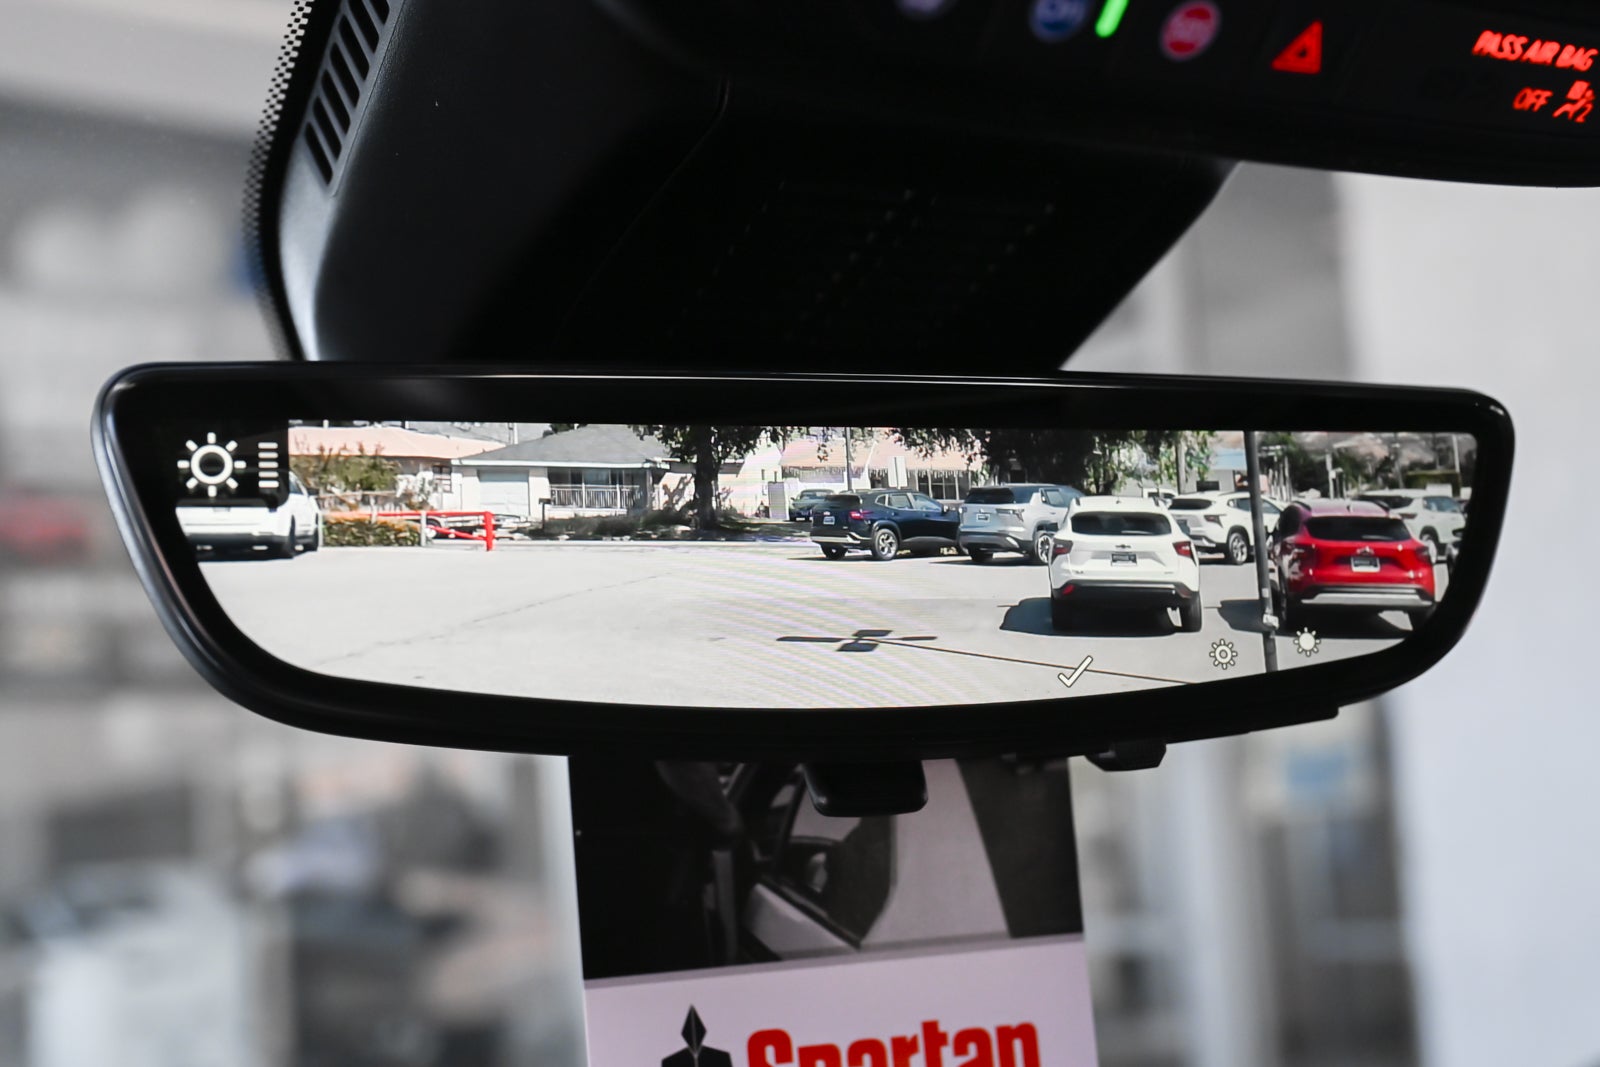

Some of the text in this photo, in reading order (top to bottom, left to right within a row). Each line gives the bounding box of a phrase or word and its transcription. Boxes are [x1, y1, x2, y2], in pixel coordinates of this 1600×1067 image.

[1472, 30, 1599, 72] PASS AIR BAG
[1513, 87, 1553, 112] OFF
